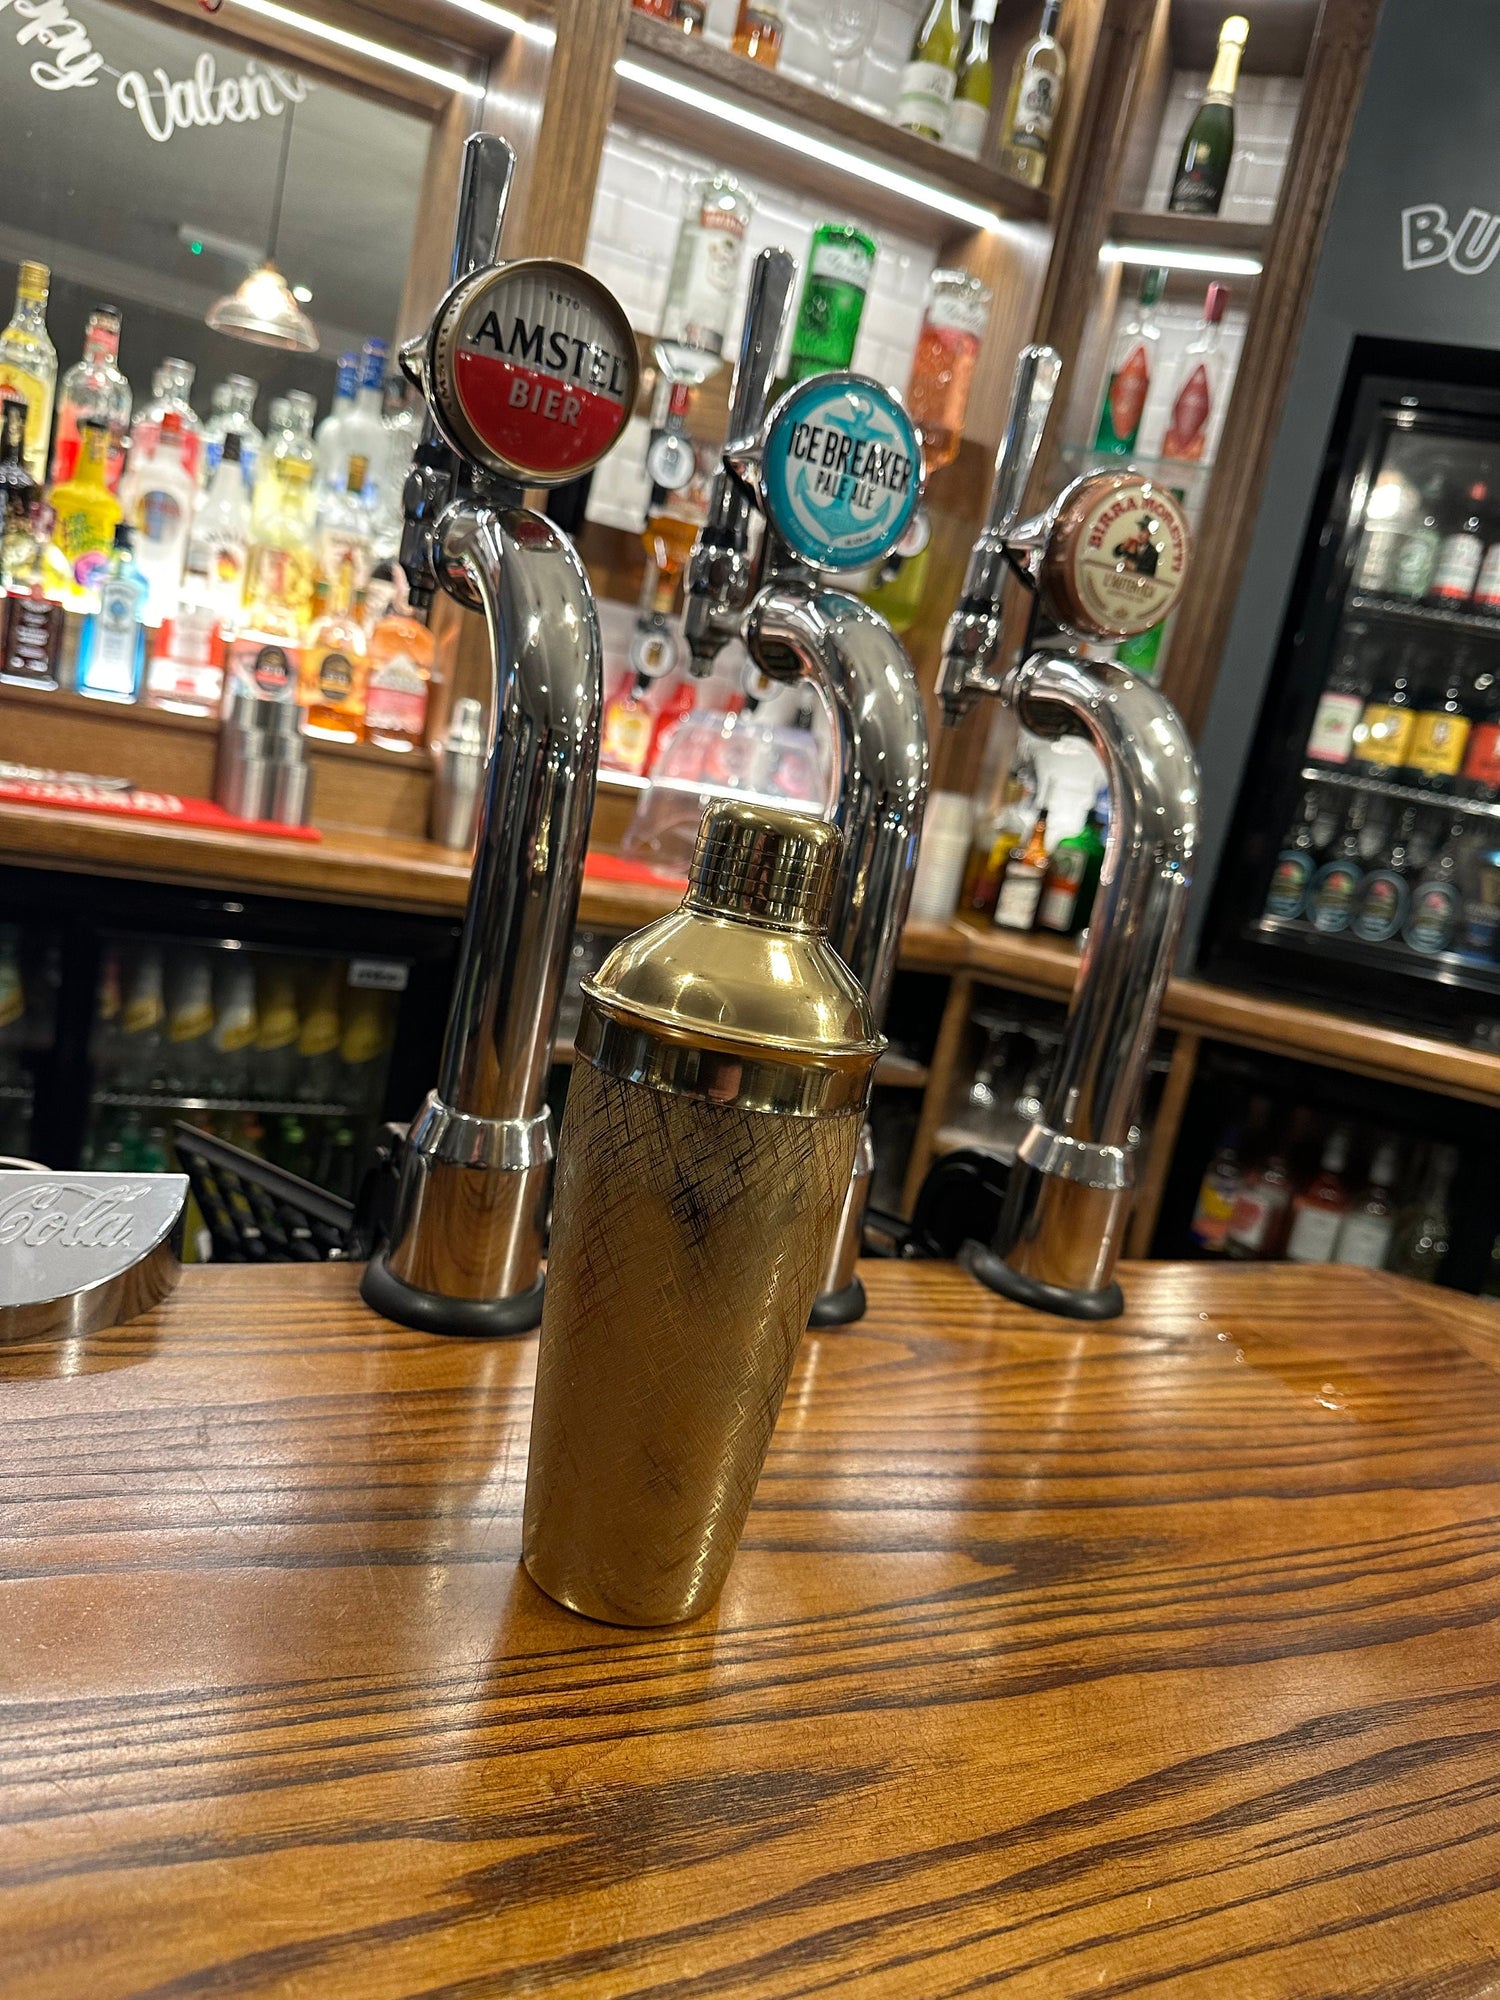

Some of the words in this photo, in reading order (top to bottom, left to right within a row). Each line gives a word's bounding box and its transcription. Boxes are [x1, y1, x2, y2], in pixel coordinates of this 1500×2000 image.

[471, 310, 625, 396] AMSTEL
[508, 377, 582, 428] BIER
[1088, 497, 1138, 549] BIRRA
[1141, 498, 1183, 572] MORETTI
[0, 1182, 152, 1248] Cola
